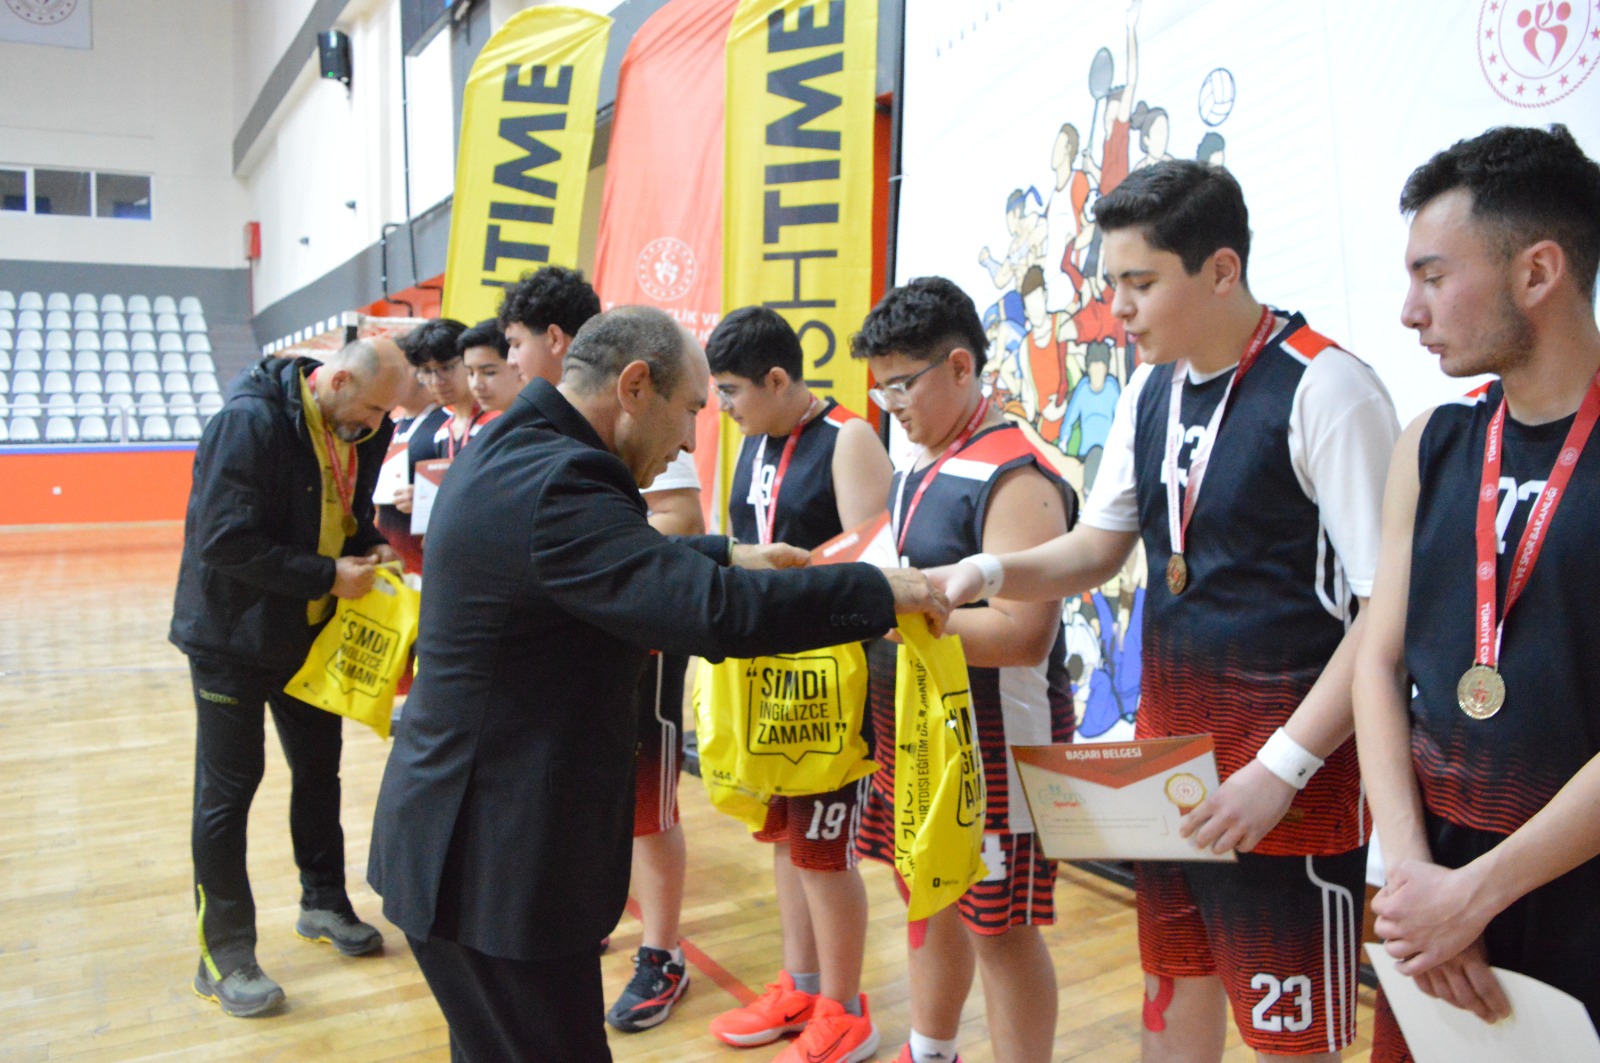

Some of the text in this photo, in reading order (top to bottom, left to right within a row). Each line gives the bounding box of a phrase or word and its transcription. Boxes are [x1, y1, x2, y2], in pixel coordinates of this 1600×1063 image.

[1519, 539, 1535, 567] SPOR
[1065, 745, 1142, 762] BAŞARI BELGESİ
[805, 799, 847, 840] 19
[1250, 972, 1313, 1032] 23
